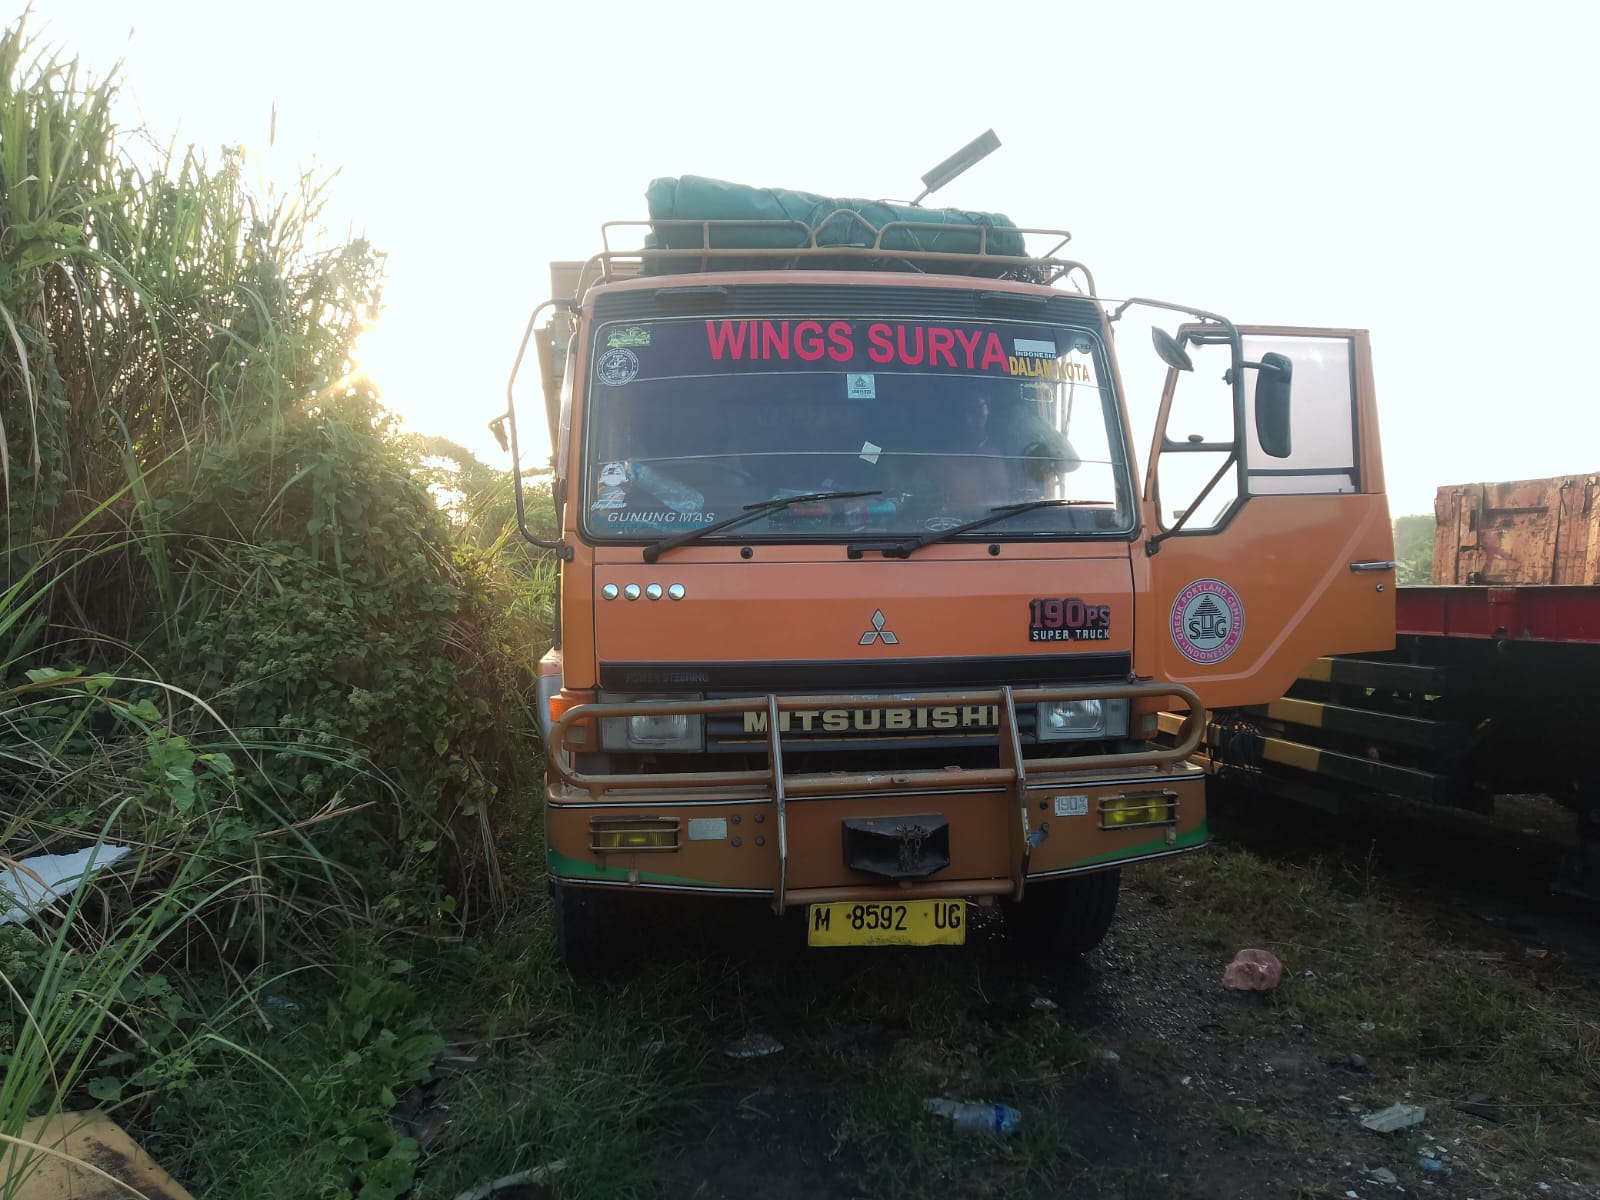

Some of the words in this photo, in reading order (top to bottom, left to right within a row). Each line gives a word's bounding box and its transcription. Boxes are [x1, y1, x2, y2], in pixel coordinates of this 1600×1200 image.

[706, 319, 854, 362] WINGS
[868, 323, 1011, 372] SURYA
[1009, 356, 1054, 379] DALAM
[1057, 361, 1091, 383] KOTA
[607, 512, 676, 522] GUNUNG
[678, 512, 715, 522] MAS
[1182, 583, 1228, 604] PORTLAND
[1174, 604, 1184, 640] GRESIK
[1227, 596, 1241, 637] CEMENT
[1033, 630, 1069, 640] SUPER
[1075, 629, 1110, 640] TRUCK
[1184, 643, 1232, 660] INDONESIA
[743, 705, 999, 732] MITSUBISHI
[815, 908, 831, 931] M
[852, 905, 907, 930] 8592
[934, 903, 961, 929] UG
